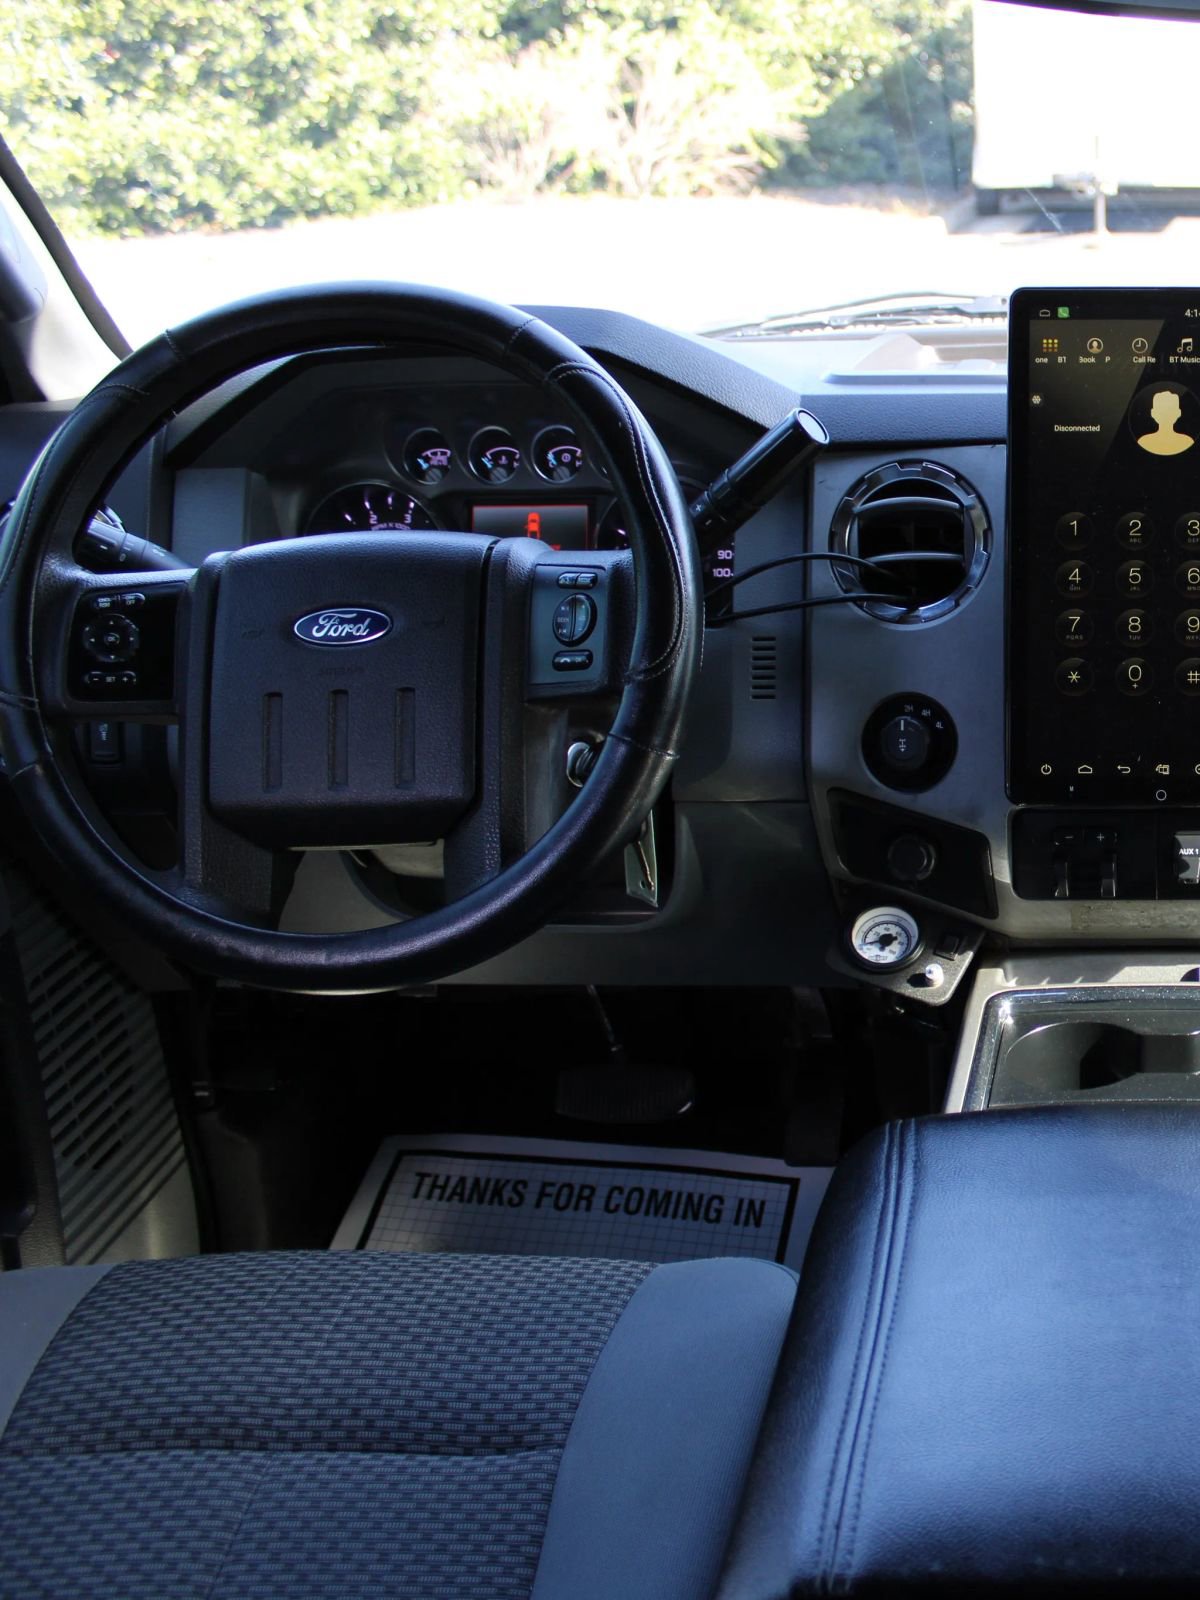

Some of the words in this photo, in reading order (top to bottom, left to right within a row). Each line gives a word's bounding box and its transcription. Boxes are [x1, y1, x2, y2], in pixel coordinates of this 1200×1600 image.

[1132, 355, 1147, 363] Call
[1147, 355, 1157, 363] Re
[1169, 355, 1179, 363] BT
[1180, 355, 1200, 363] Music
[1053, 424, 1101, 433] Disconnected
[369, 514, 378, 524] 2
[403, 513, 412, 524] 3
[1069, 519, 1078, 536] 1
[1128, 519, 1142, 536] 2
[1187, 519, 1200, 536] 3
[717, 549, 733, 560] 90
[712, 567, 731, 577] 100
[1068, 567, 1082, 584] 4
[1128, 567, 1142, 584] 5
[1187, 567, 1200, 584] 6
[311, 612, 371, 638] Ford
[1068, 616, 1081, 632] 7
[1128, 616, 1142, 633] 8
[1187, 616, 1200, 633] 9
[1128, 664, 1142, 682] 0
[1187, 670, 1200, 684] #
[935, 721, 944, 729] 4L
[411, 1172, 526, 1208] THANKS
[535, 1182, 597, 1212] FOR
[604, 1186, 724, 1224] COMING
[733, 1199, 766, 1228] IN
